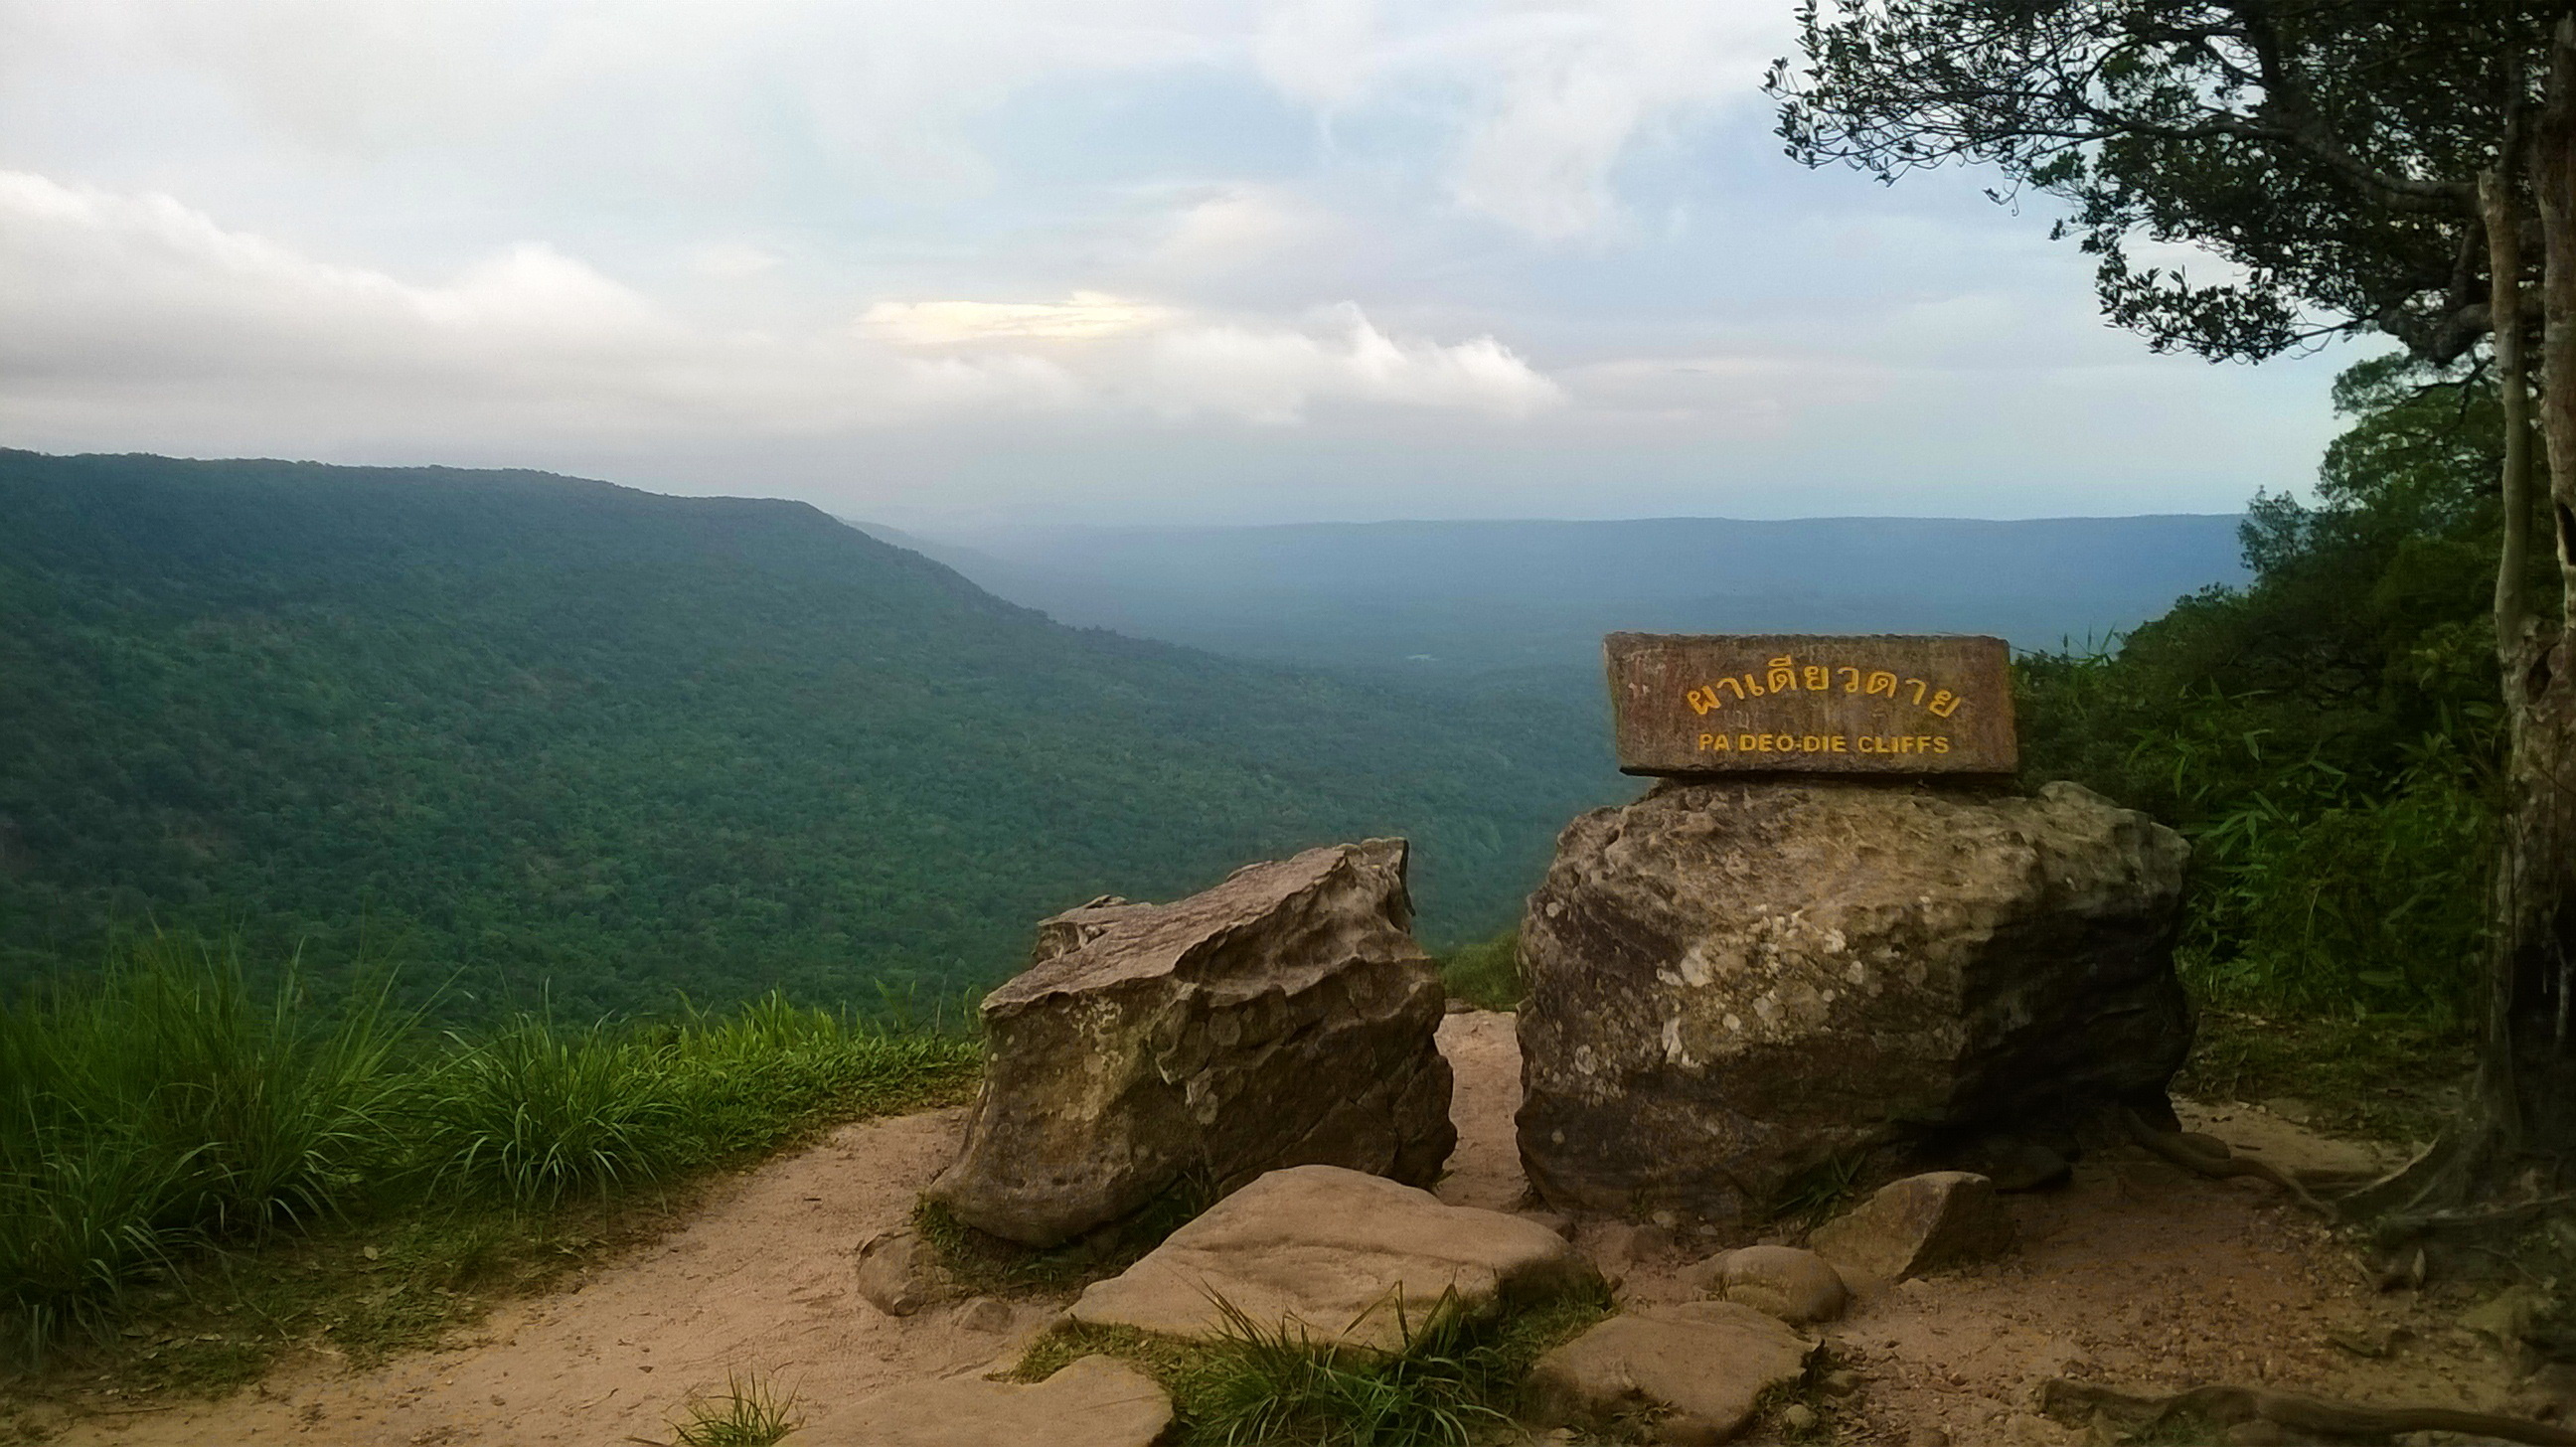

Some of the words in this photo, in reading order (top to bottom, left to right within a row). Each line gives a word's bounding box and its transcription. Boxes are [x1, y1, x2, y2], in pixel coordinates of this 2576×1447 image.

[1688, 654, 1962, 719] ผาเดียวดาย
[1698, 733, 1730, 751] PA
[1739, 734, 1847, 752] DEO-DIE
[1857, 735, 1950, 753] CLIFFS
